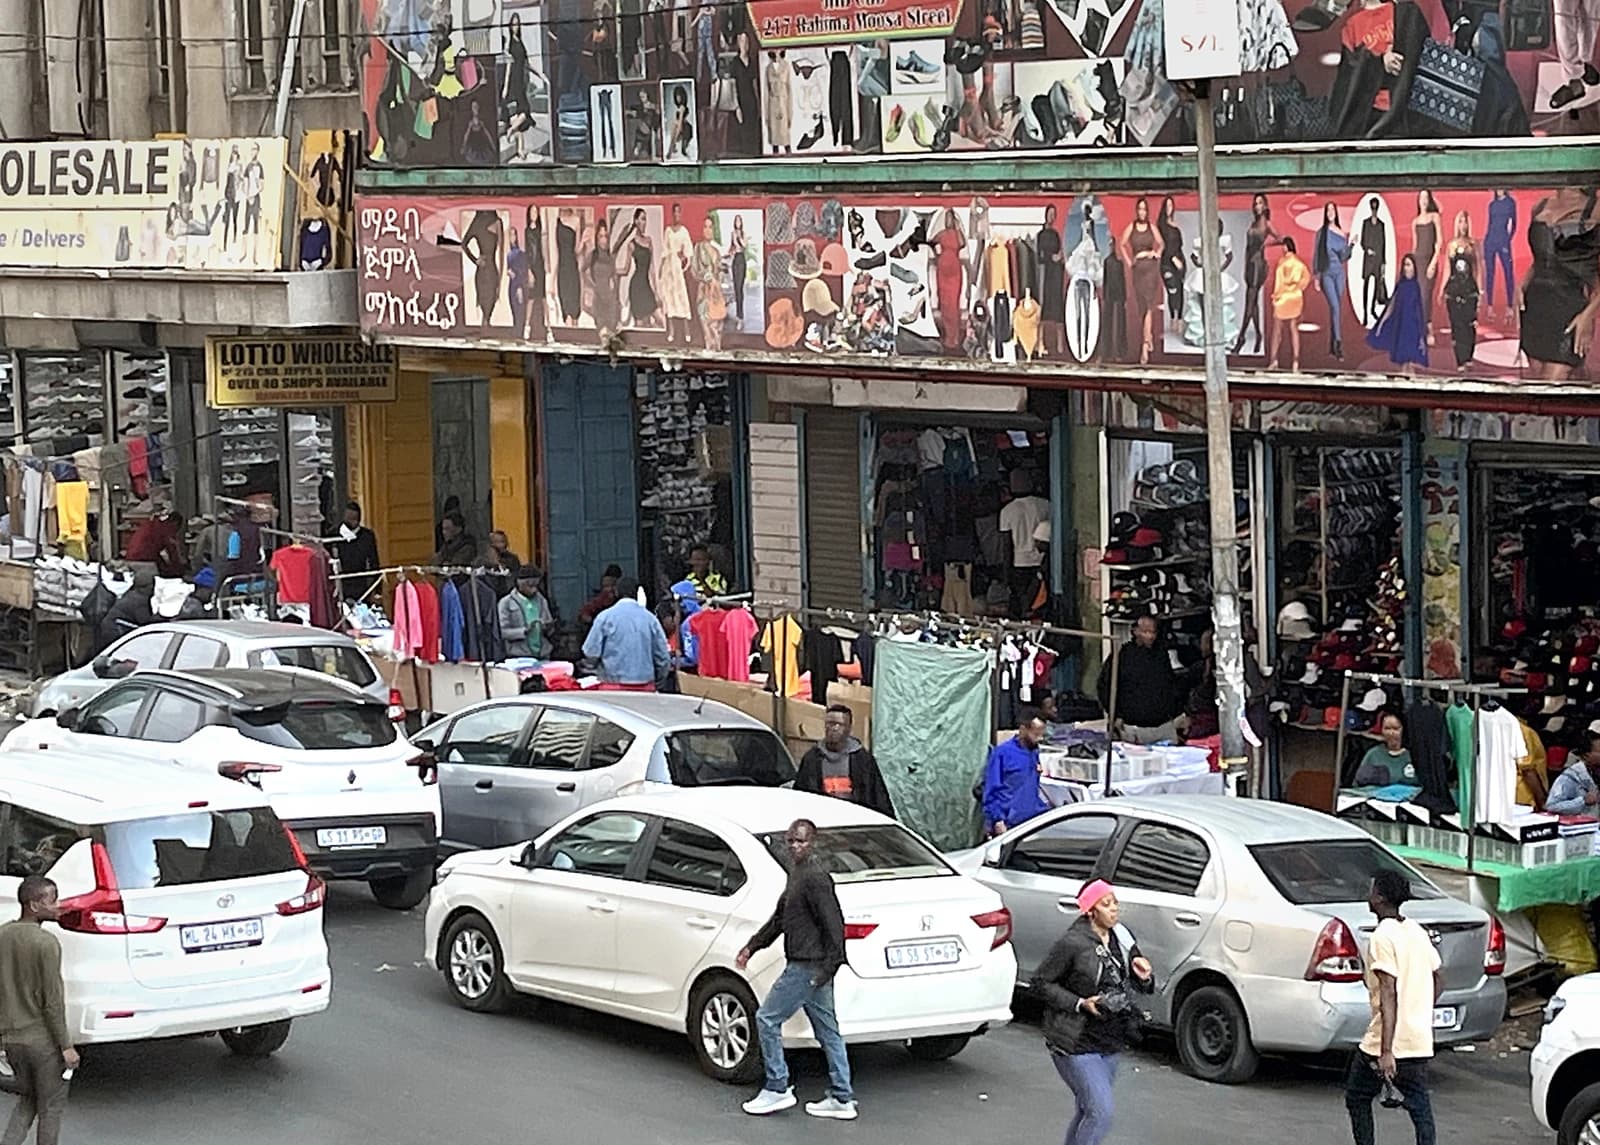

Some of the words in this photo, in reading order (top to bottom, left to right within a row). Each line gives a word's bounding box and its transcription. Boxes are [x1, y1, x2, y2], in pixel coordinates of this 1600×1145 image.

[906, 6, 952, 27] Street
[22, 228, 85, 248] Delvers
[221, 343, 286, 366] LOTTO
[291, 341, 393, 365] WHOLESALE
[228, 378, 260, 390] OVER
[262, 378, 279, 389] 40
[281, 377, 323, 389] SHOPS
[326, 376, 388, 388] AVAILABLE
[245, 921, 259, 937] GP
